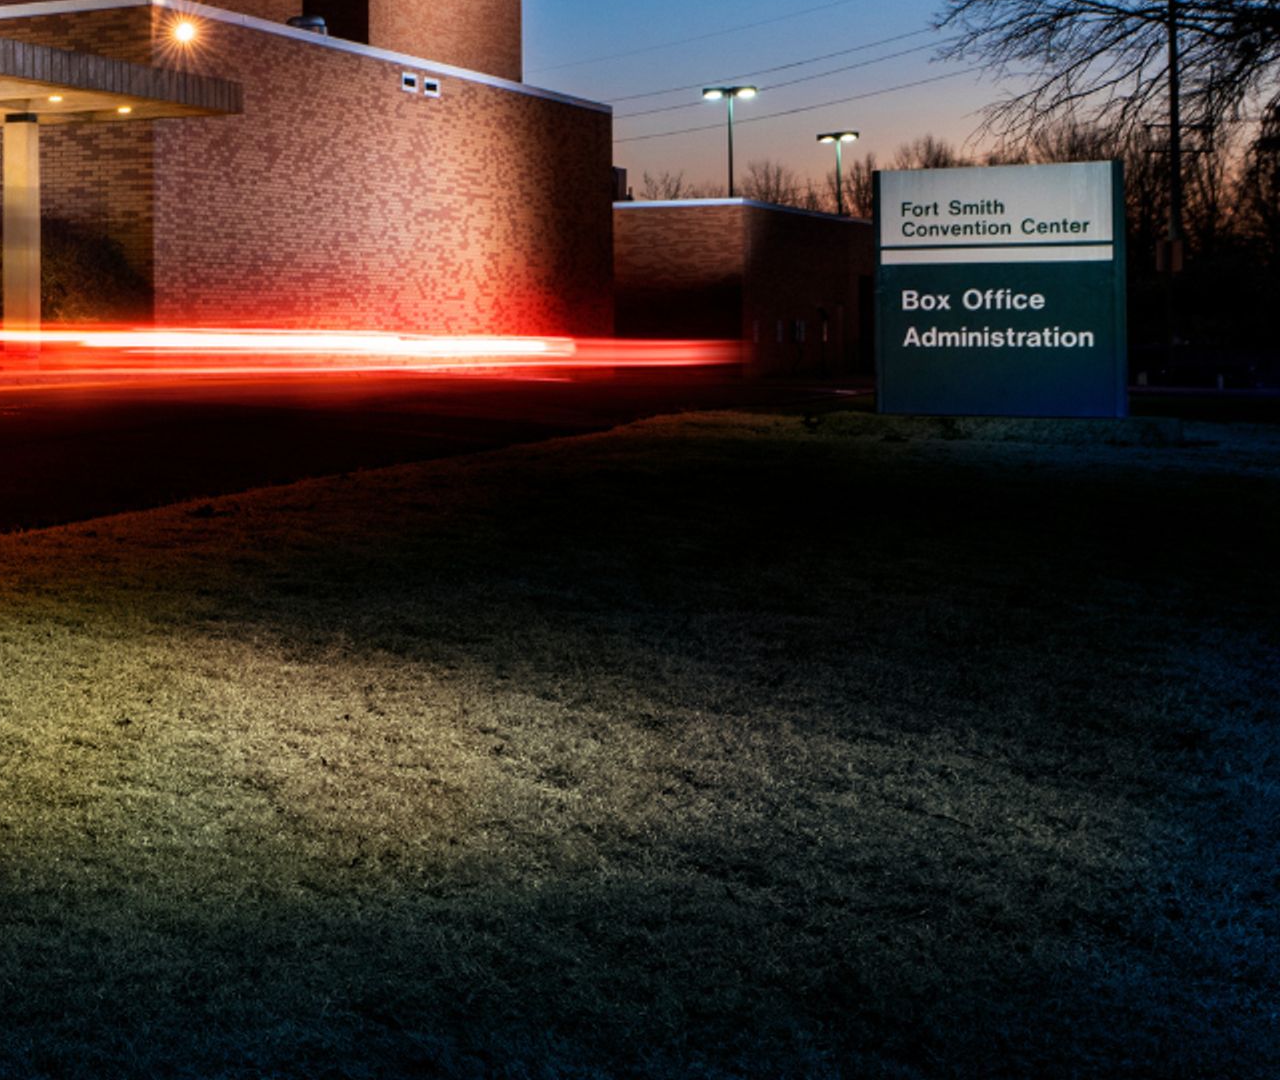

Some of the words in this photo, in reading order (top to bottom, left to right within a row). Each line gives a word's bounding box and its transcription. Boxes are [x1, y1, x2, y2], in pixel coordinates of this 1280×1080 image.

[901, 201, 939, 218] Fort
[948, 199, 1005, 216] Smith
[901, 220, 1012, 238] Convention
[1021, 218, 1090, 235] Center
[901, 289, 951, 311] Box
[962, 288, 1046, 311] Office
[902, 326, 1095, 348] Administration
